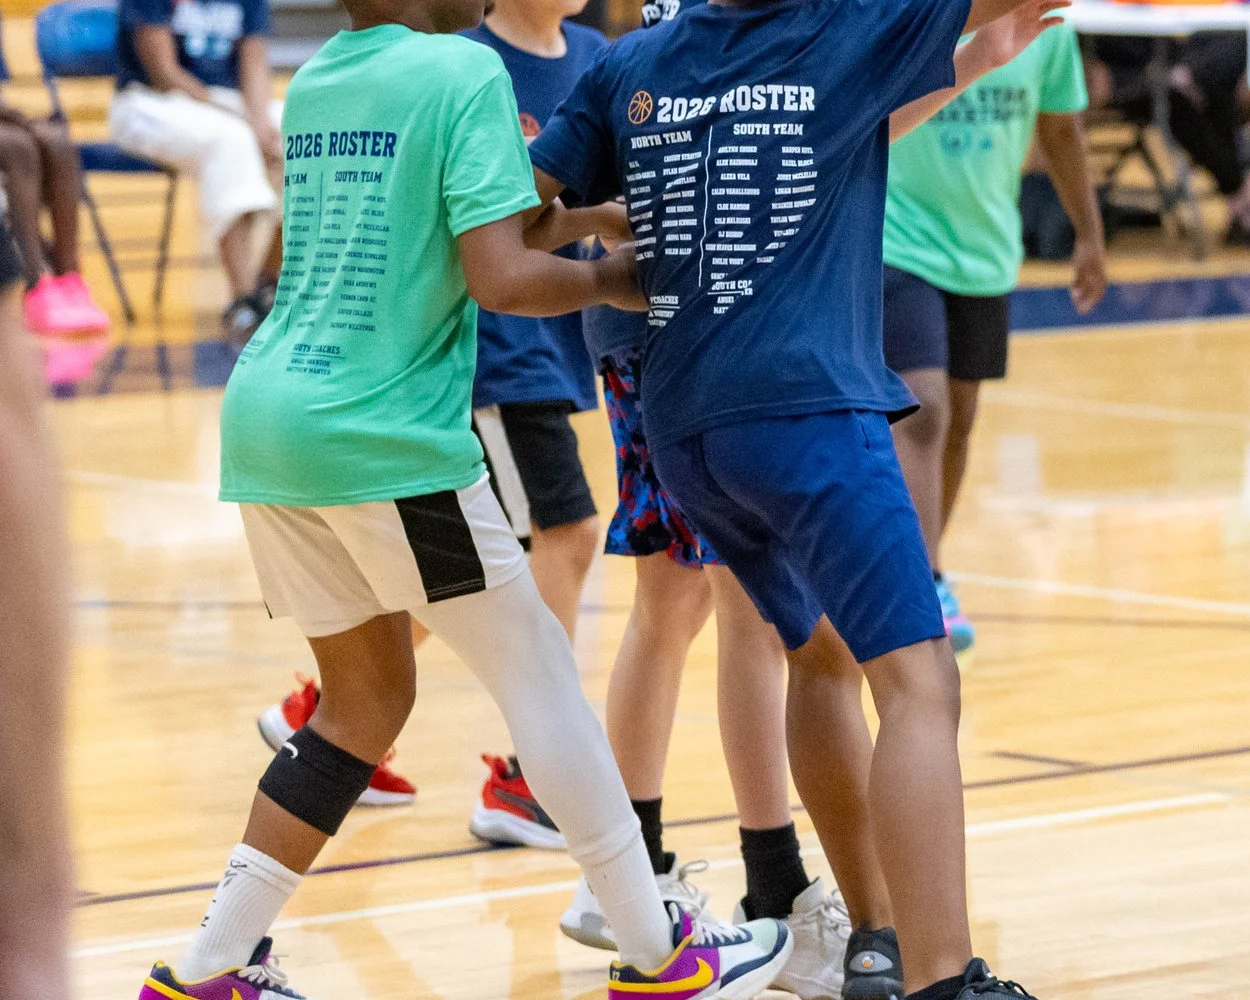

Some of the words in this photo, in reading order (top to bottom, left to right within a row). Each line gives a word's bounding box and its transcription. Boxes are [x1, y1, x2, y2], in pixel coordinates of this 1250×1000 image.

[657, 96, 717, 123] 2026
[719, 84, 815, 112] ROSTER
[733, 123, 771, 135] SOUTH
[773, 123, 804, 136] TEAM
[286, 132, 323, 160] 2026
[328, 131, 397, 158] ROSTER
[630, 134, 662, 149] NORTH
[662, 130, 692, 144] TEAM
[335, 171, 359, 182] SOUTH
[361, 171, 383, 183] TEAM
[653, 295, 679, 305] COACHES
[312, 344, 341, 355] ACHES
